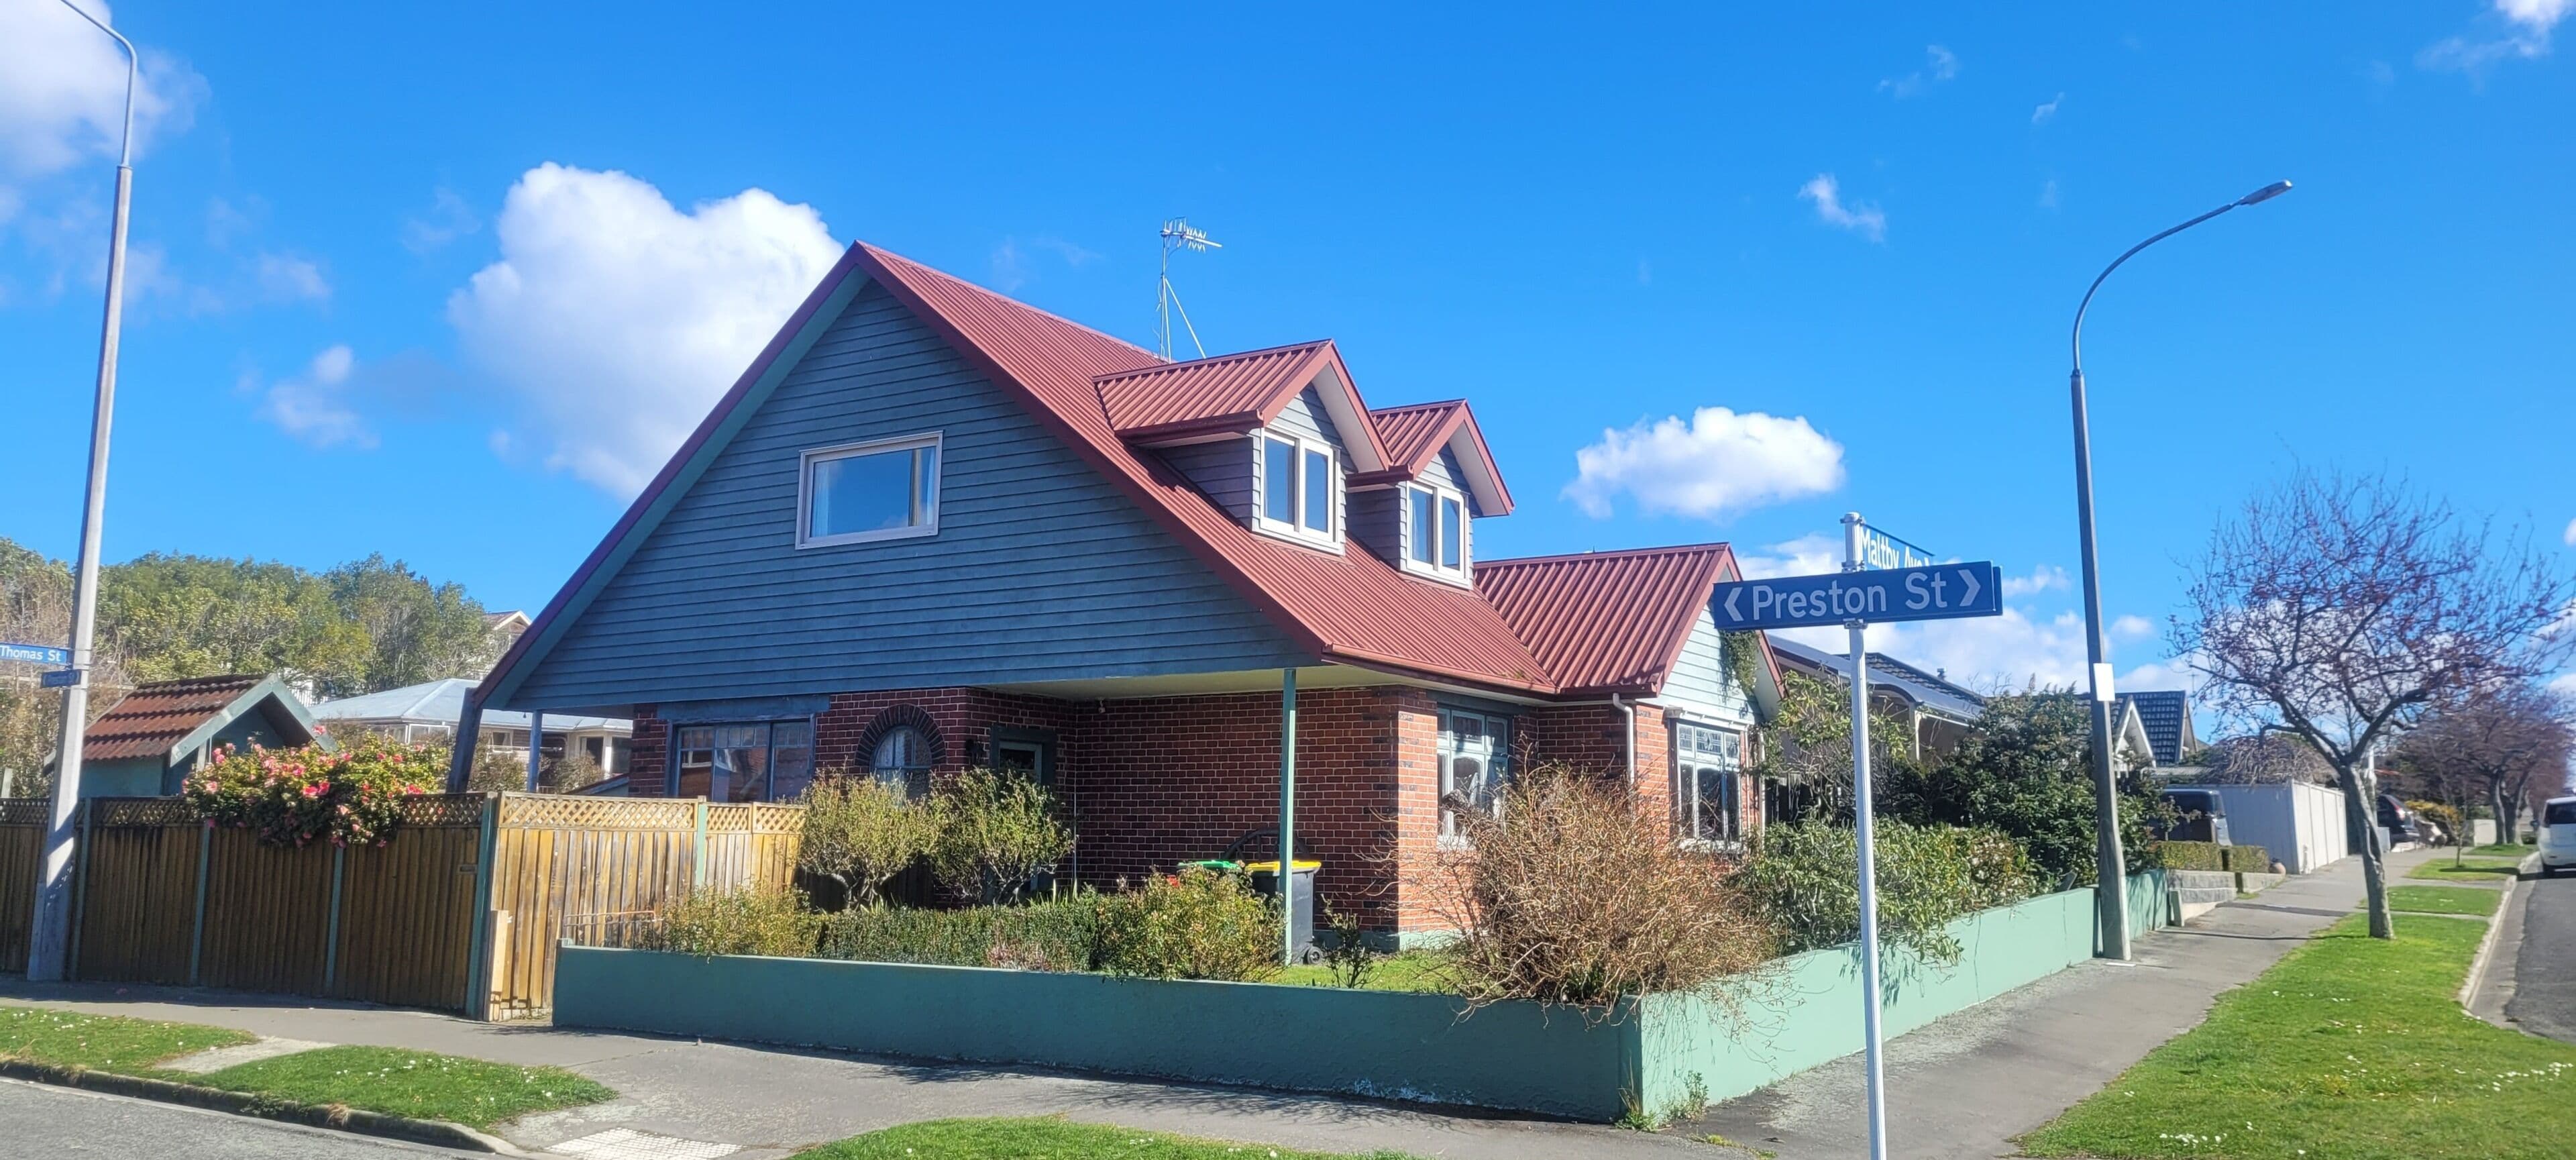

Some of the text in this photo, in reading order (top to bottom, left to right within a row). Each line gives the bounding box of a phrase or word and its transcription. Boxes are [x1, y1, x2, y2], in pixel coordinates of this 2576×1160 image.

[1860, 527, 1899, 569] Maltby
[1753, 572, 1947, 620] Preston St
[0, 645, 61, 662] Thomas St
